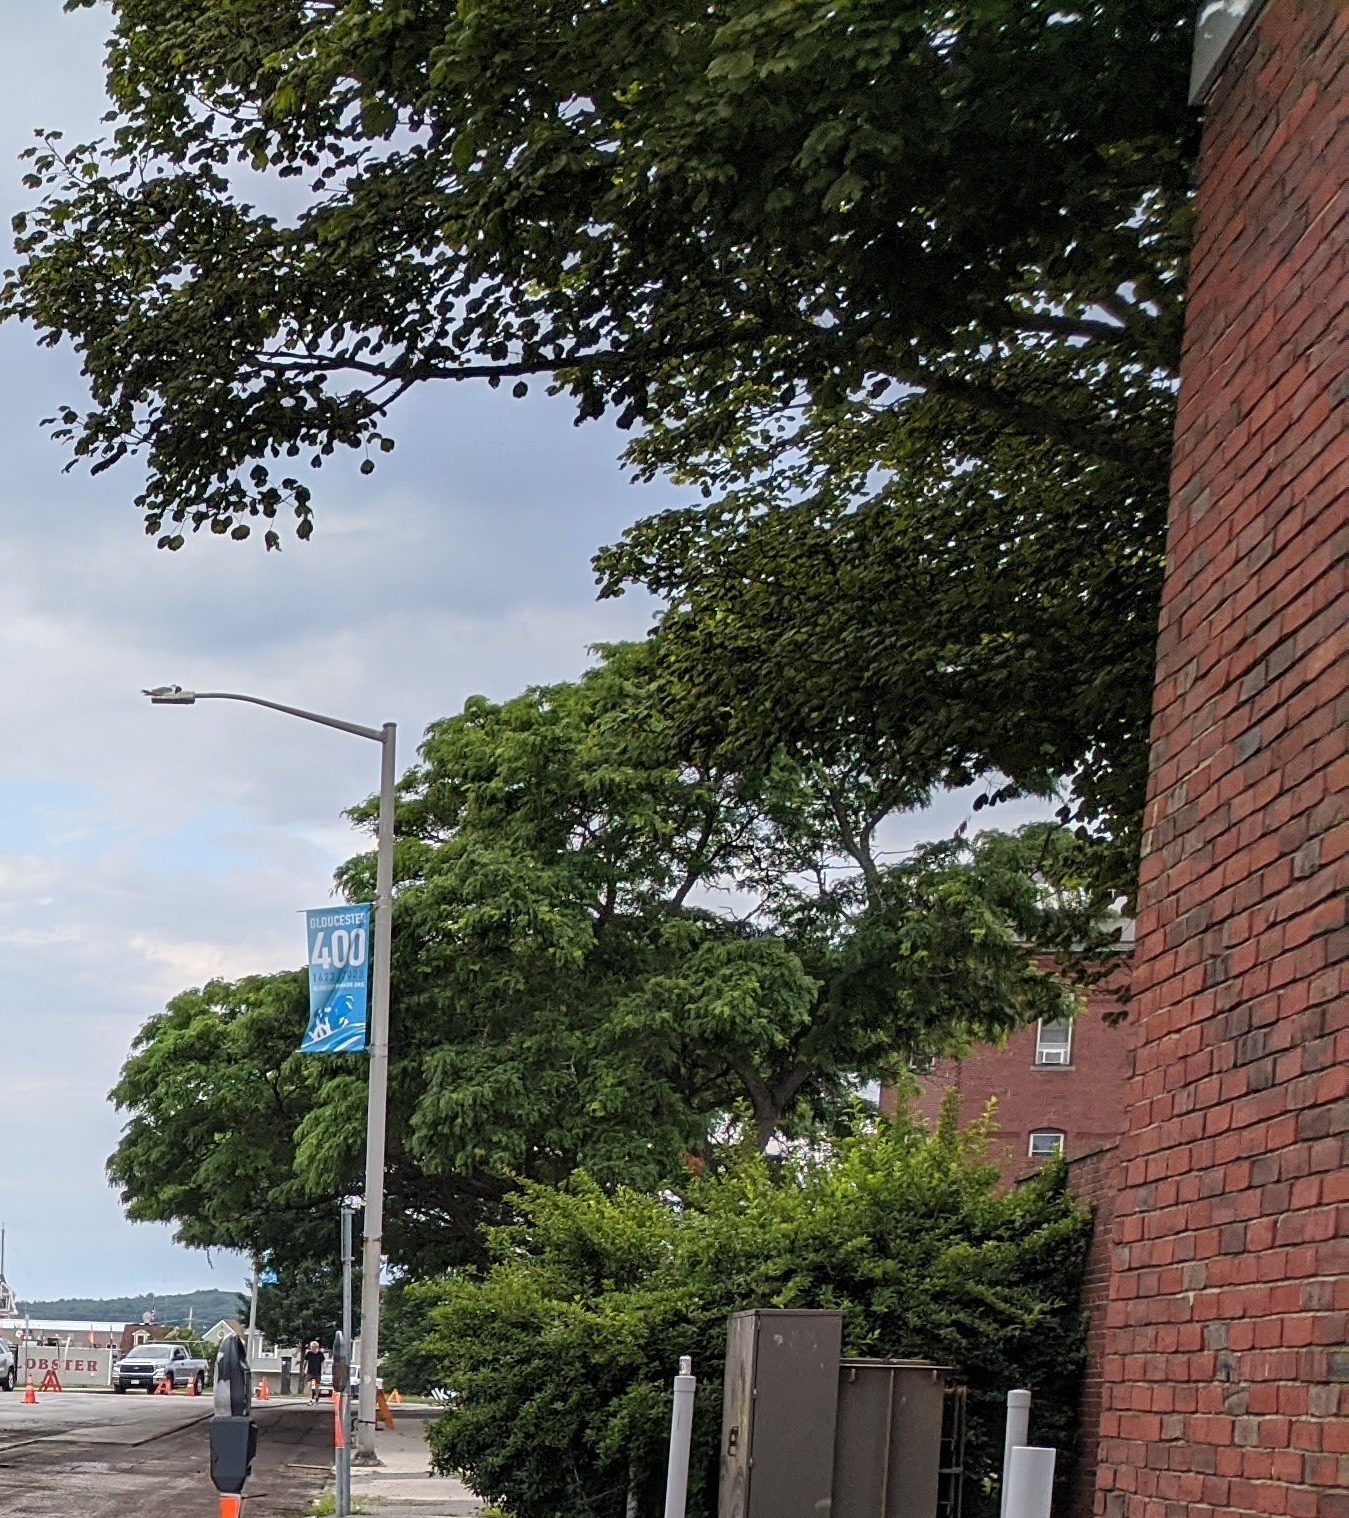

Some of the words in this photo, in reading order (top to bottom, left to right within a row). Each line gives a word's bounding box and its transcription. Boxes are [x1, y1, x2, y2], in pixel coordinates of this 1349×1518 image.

[310, 912, 366, 929] GLOUCESTER
[311, 928, 366, 970] 400
[18, 1358, 98, 1372] OBSTER
